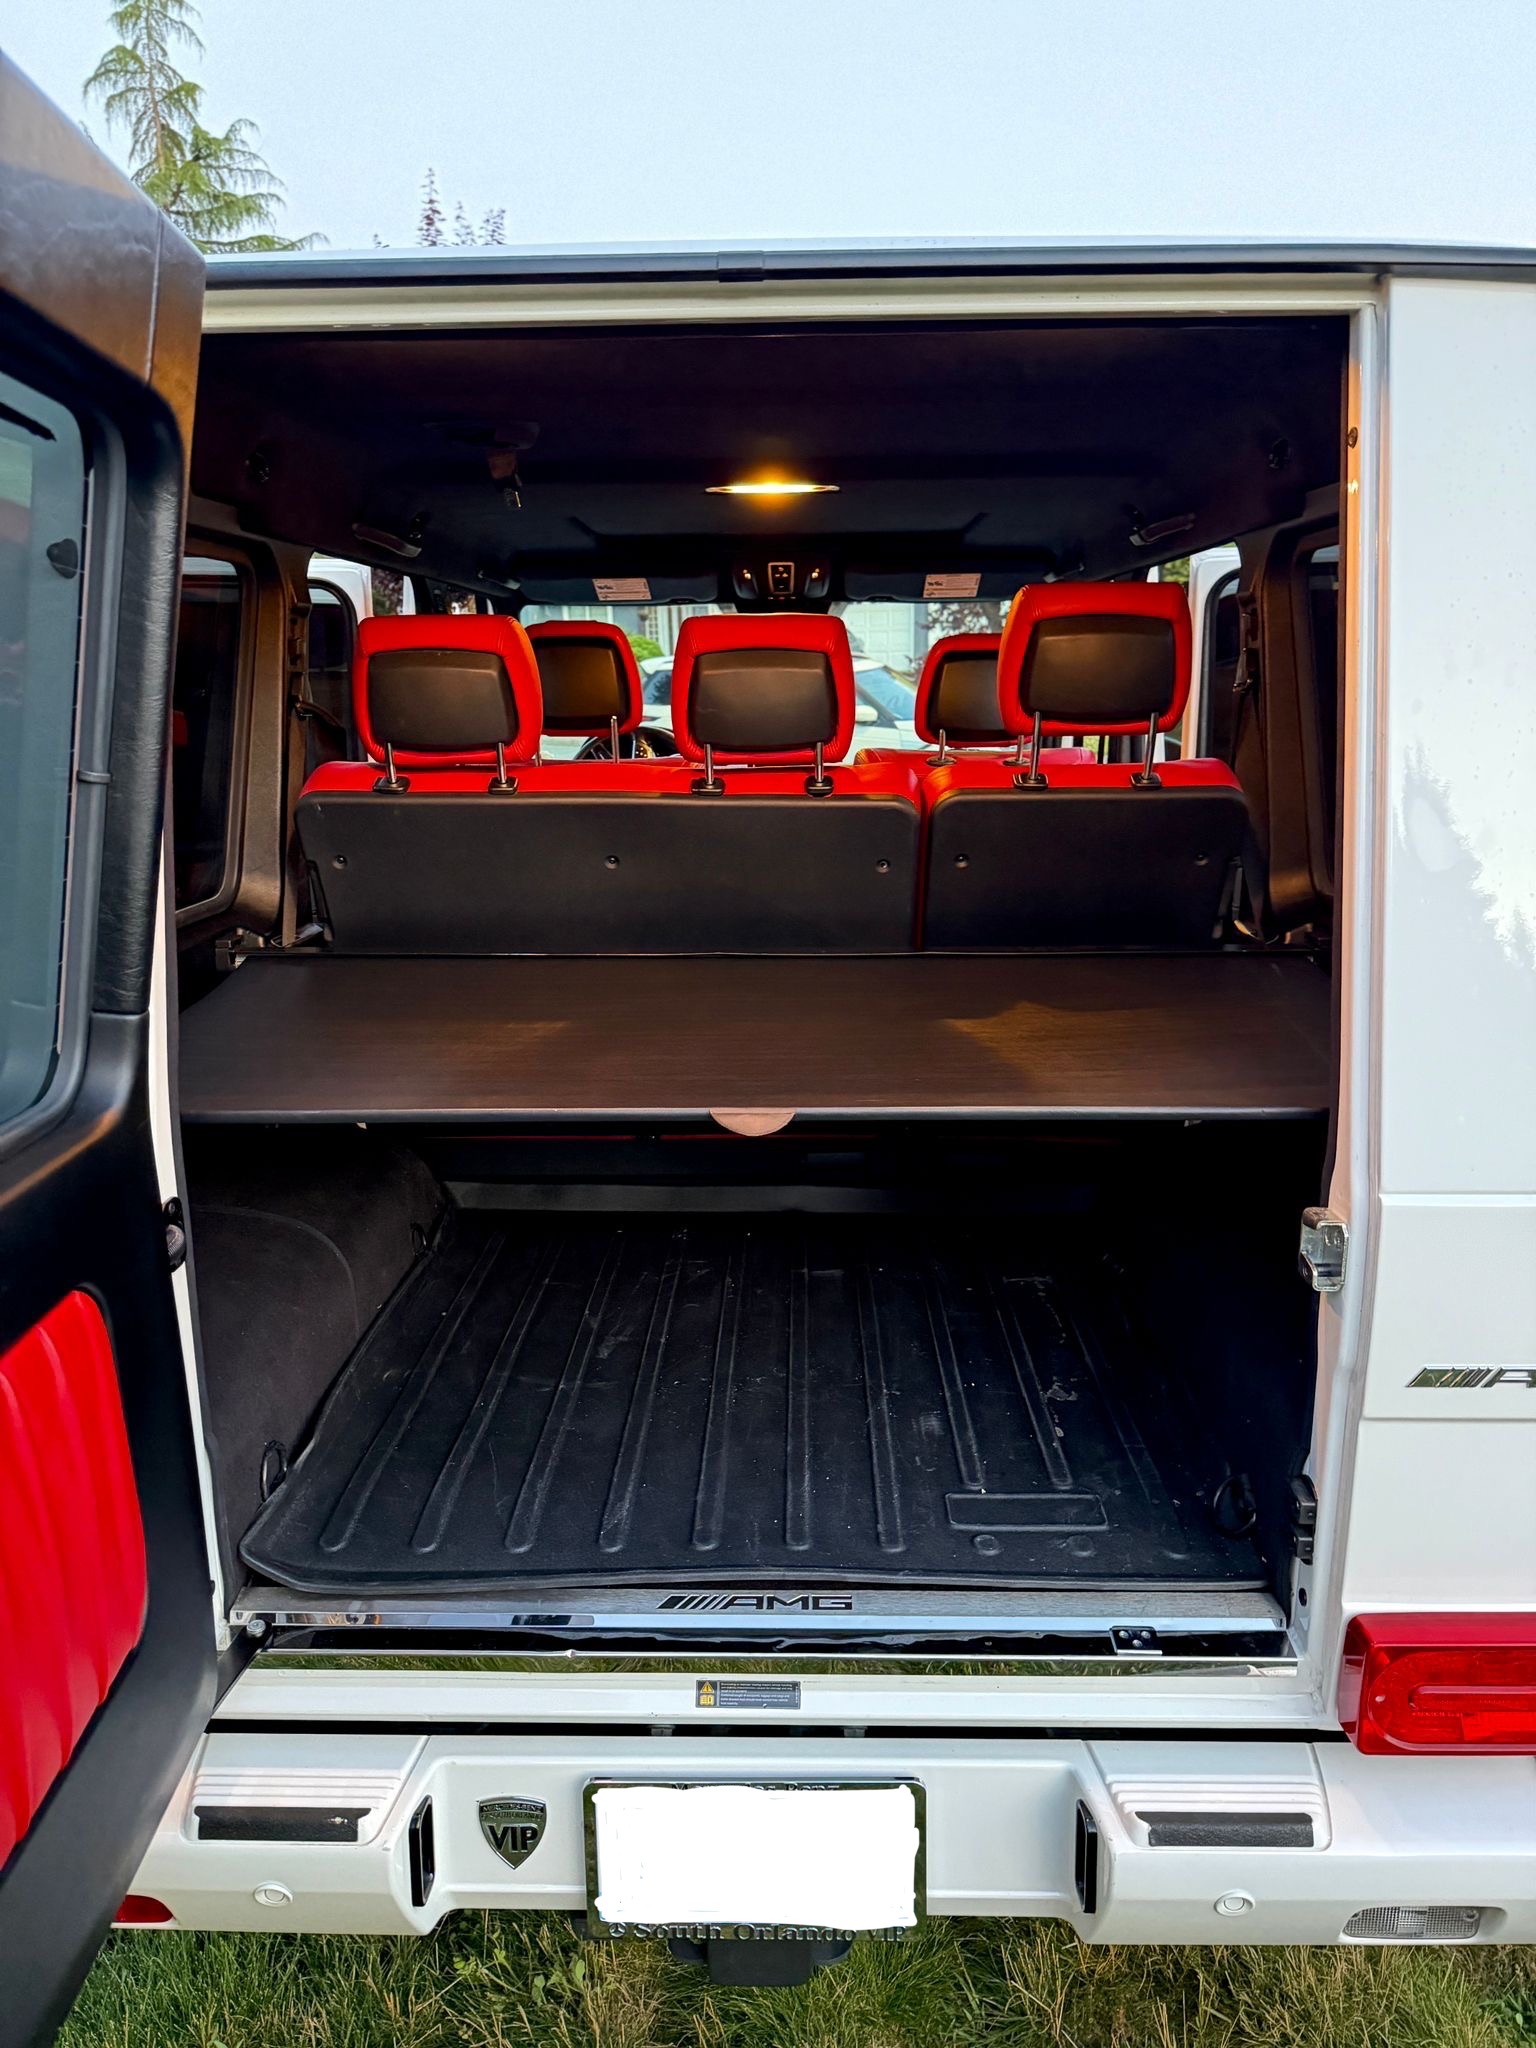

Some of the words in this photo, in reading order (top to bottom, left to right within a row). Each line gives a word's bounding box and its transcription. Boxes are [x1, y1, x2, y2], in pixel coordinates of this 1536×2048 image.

[719, 1594, 852, 1610] AMG
[487, 1823, 538, 1852] VIP
[633, 1922, 724, 1939] South
